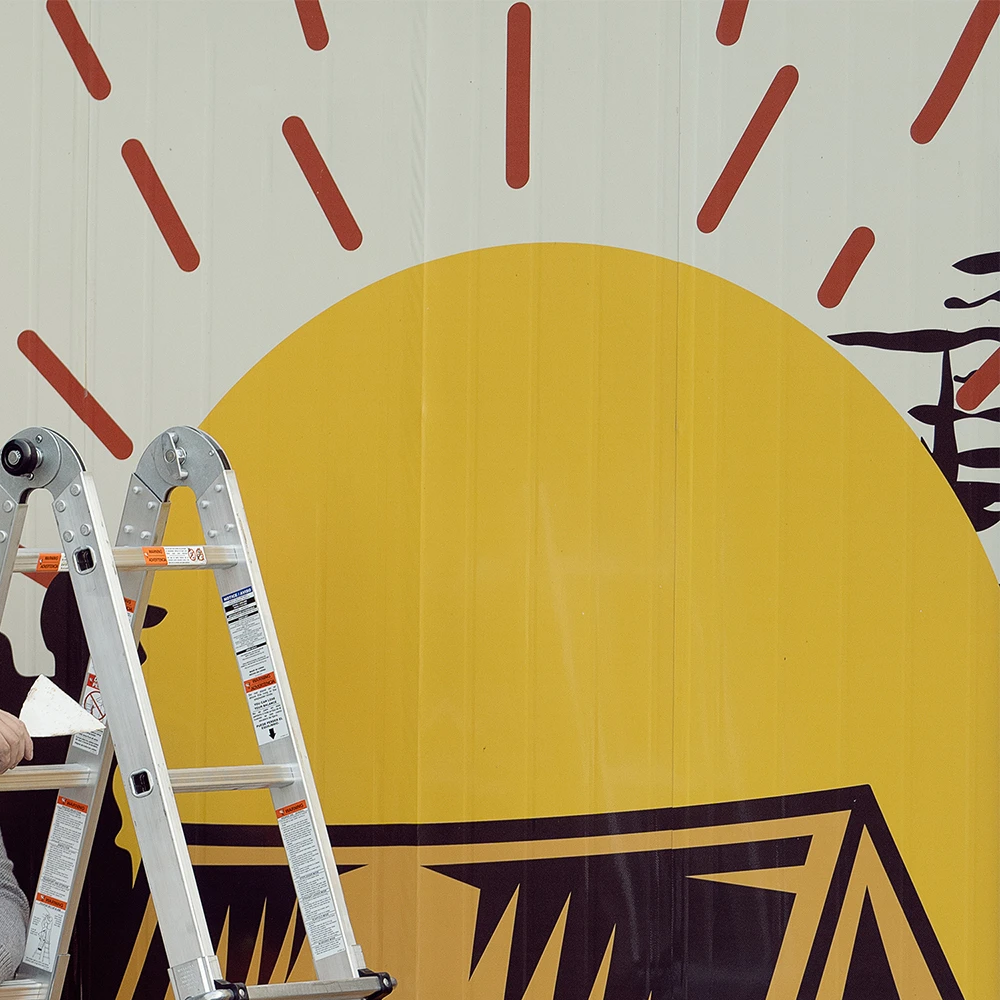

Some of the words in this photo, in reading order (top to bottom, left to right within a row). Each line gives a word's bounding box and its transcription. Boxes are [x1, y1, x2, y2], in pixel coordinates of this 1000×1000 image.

[66, 801, 85, 811] WARNING
[285, 802, 304, 813] WARNING
[45, 897, 64, 908] WARNING
